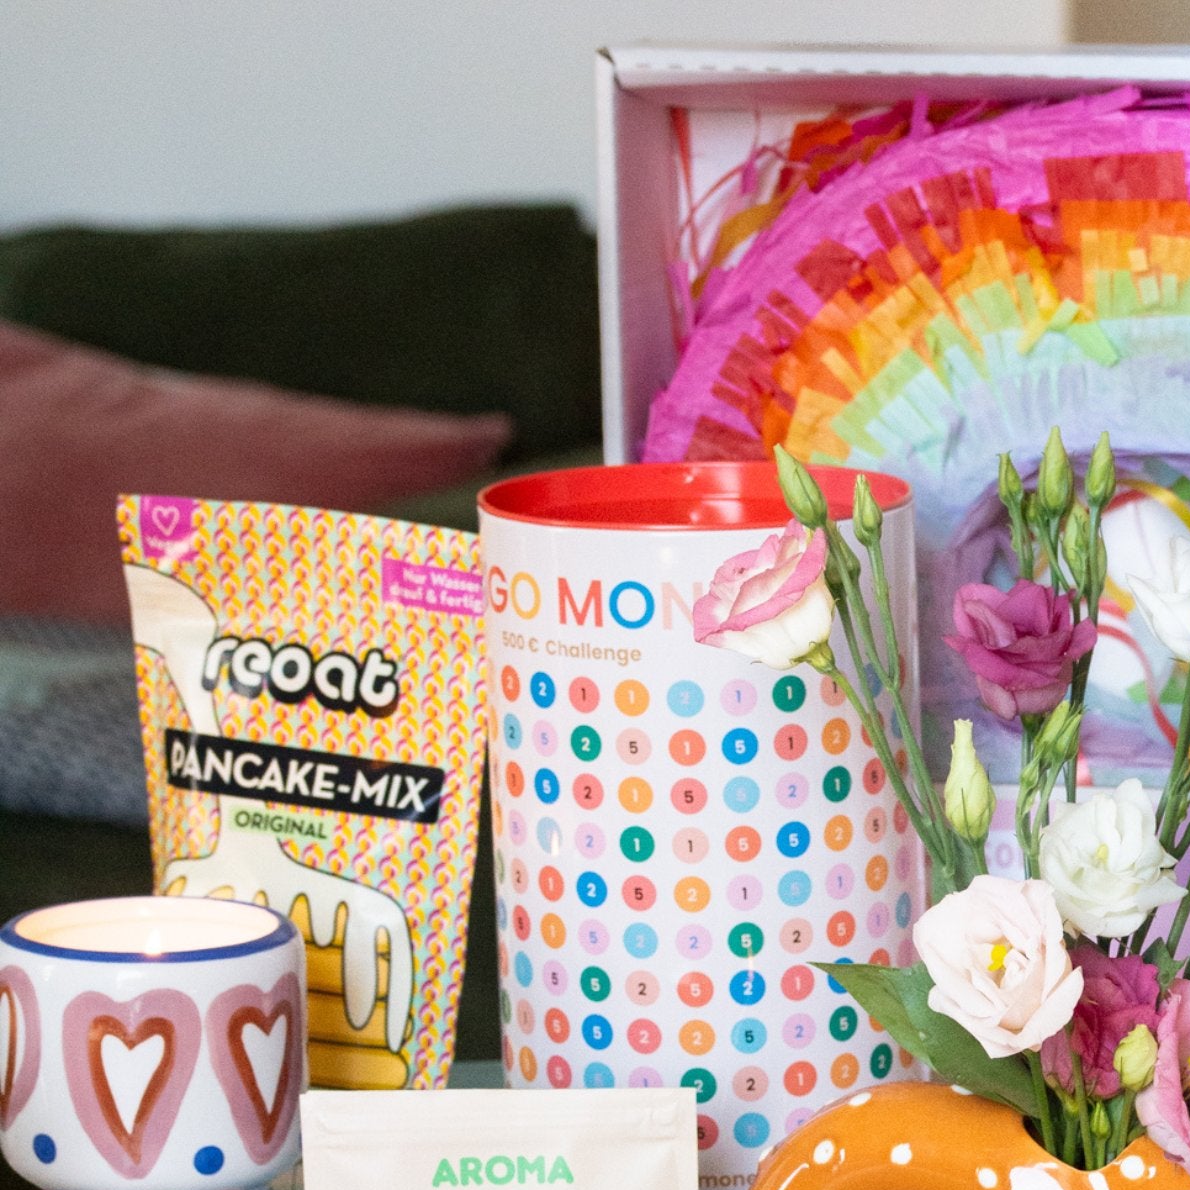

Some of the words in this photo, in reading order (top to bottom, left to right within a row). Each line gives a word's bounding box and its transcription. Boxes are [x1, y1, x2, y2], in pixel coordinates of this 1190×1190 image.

[488, 565, 541, 620] GO
[502, 630, 525, 650] 500
[528, 637, 539, 653] €
[545, 639, 642, 667] Challenge
[581, 737, 591, 752] 2
[629, 741, 639, 754] 5
[735, 740, 746, 754] 5
[171, 740, 430, 812] PANCAKE-MIX
[684, 790, 694, 804] 5
[788, 785, 797, 799] 2
[235, 811, 327, 840] ORIGINAL
[738, 837, 749, 851] 5
[789, 833, 799, 848] 5
[586, 883, 596, 898] 2
[634, 887, 644, 901] 5
[638, 983, 647, 996] 2
[743, 981, 753, 996] 2
[744, 1030, 754, 1044] 5
[795, 1025, 804, 1039] 2
[746, 1078, 755, 1092] 2
[432, 1155, 574, 1188] AROMA
